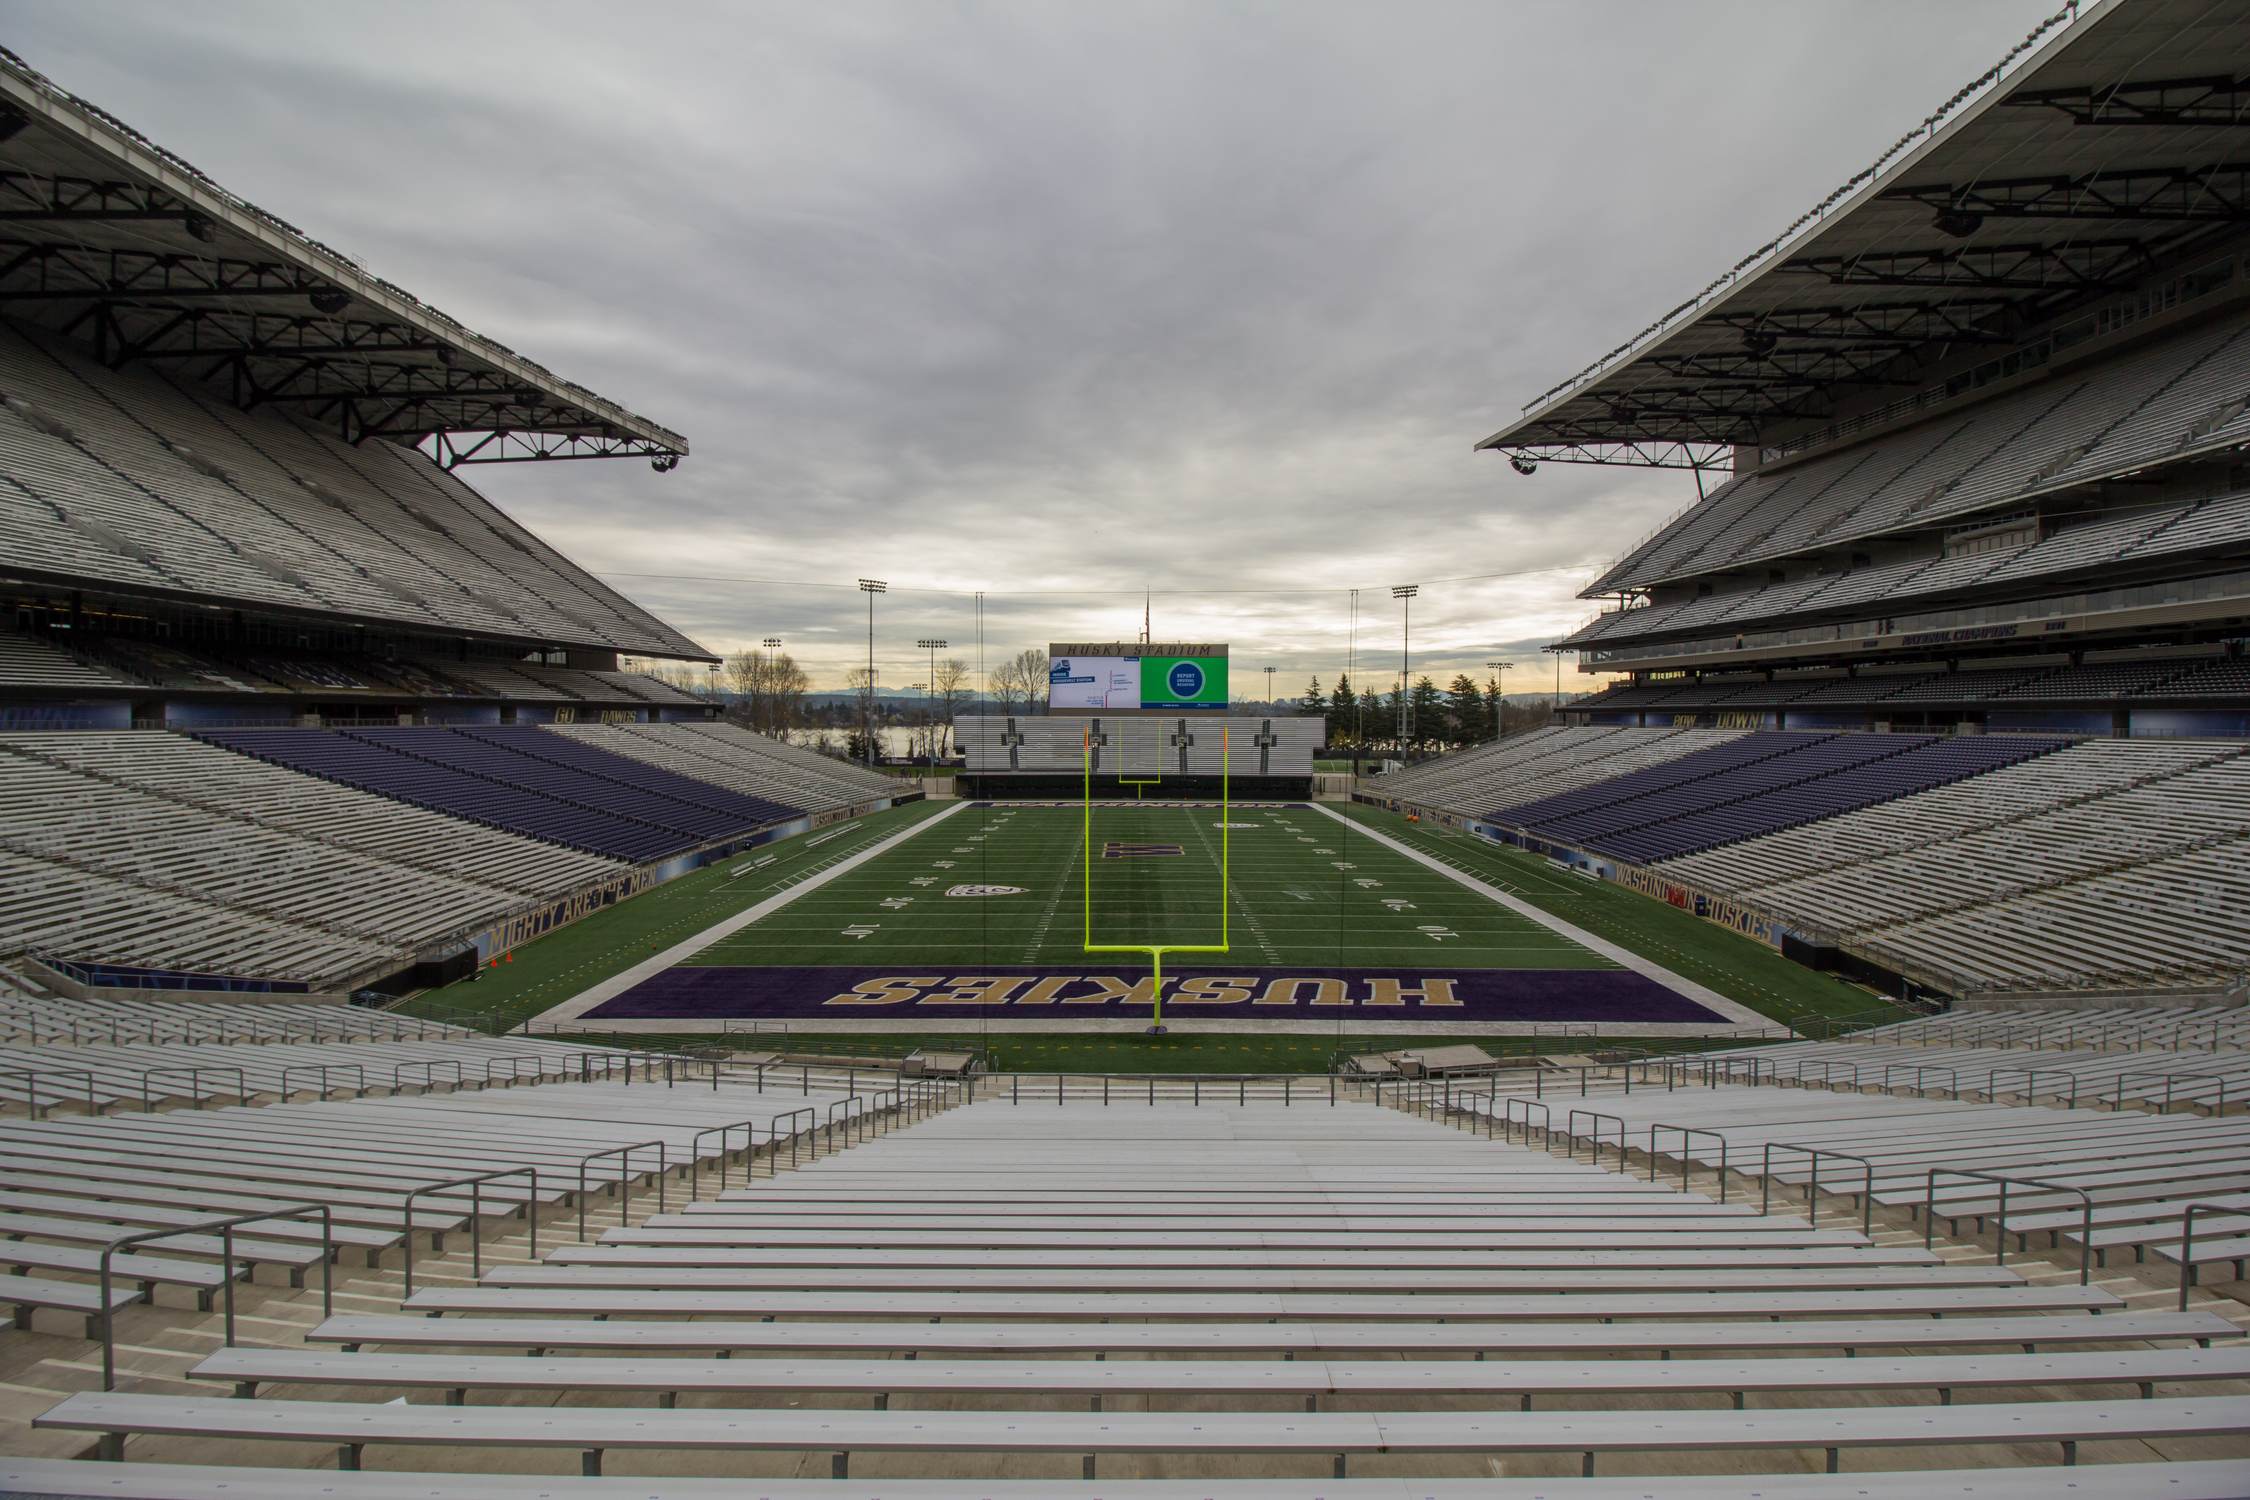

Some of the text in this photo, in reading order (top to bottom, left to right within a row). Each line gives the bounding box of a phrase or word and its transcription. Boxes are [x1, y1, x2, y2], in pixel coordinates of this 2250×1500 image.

[1067, 645, 1210, 656] HUSKY STADIUM
[554, 707, 637, 724] GO DAWGS
[1673, 713, 1697, 728] BOW
[488, 902, 559, 955] MIGHTY
[562, 890, 592, 923] ARE
[629, 866, 657, 897] MEN
[822, 976, 1465, 1007] HUSKIES
